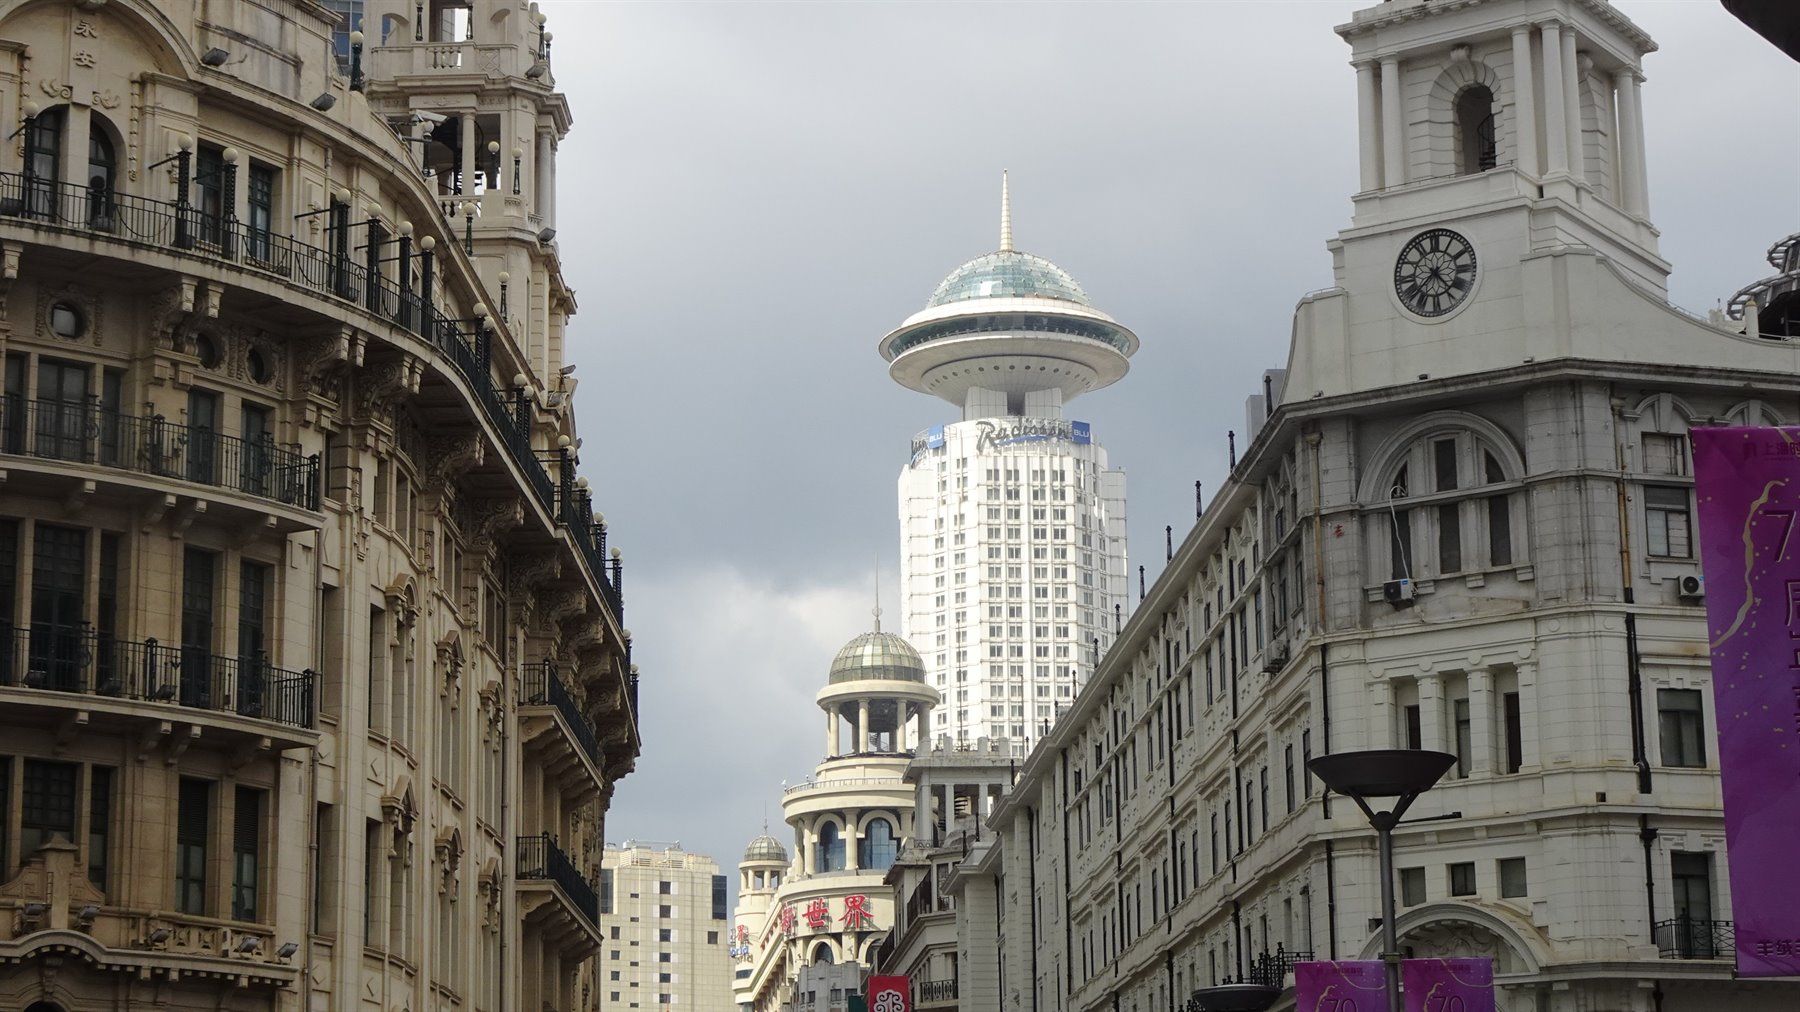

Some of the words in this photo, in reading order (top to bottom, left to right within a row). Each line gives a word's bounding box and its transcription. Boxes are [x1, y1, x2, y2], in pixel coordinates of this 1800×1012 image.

[73, 18, 97, 69] 永安
[975, 415, 1072, 455] Radisson
[1073, 429, 1090, 438] BLU
[781, 895, 874, 932] 新世界
